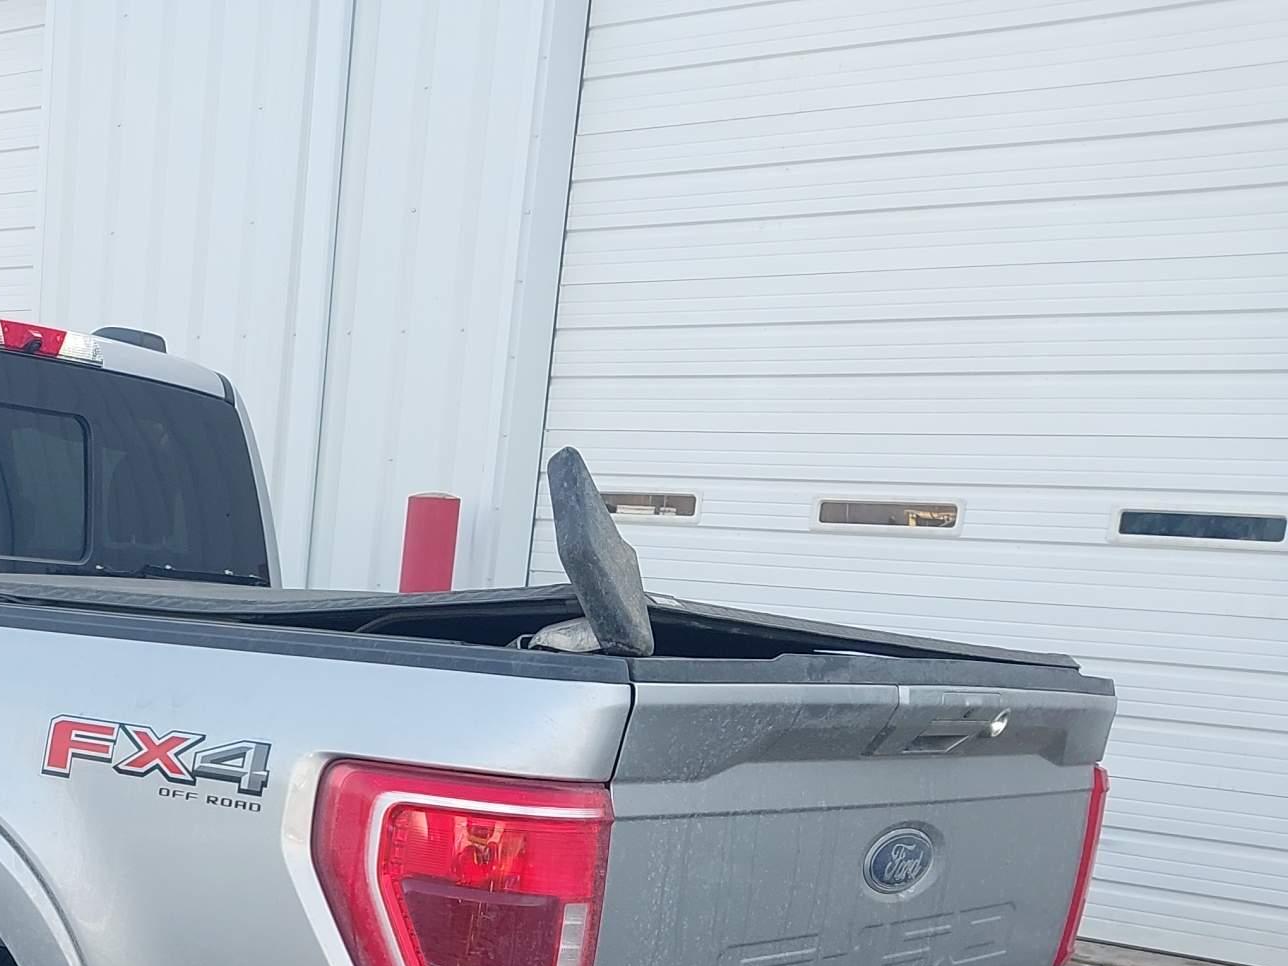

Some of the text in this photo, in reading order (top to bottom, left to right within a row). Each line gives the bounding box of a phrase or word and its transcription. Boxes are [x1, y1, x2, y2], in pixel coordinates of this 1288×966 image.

[41, 713, 272, 797] FX4
[158, 787, 262, 812] OFF ROAD
[884, 843, 924, 881] Ford
